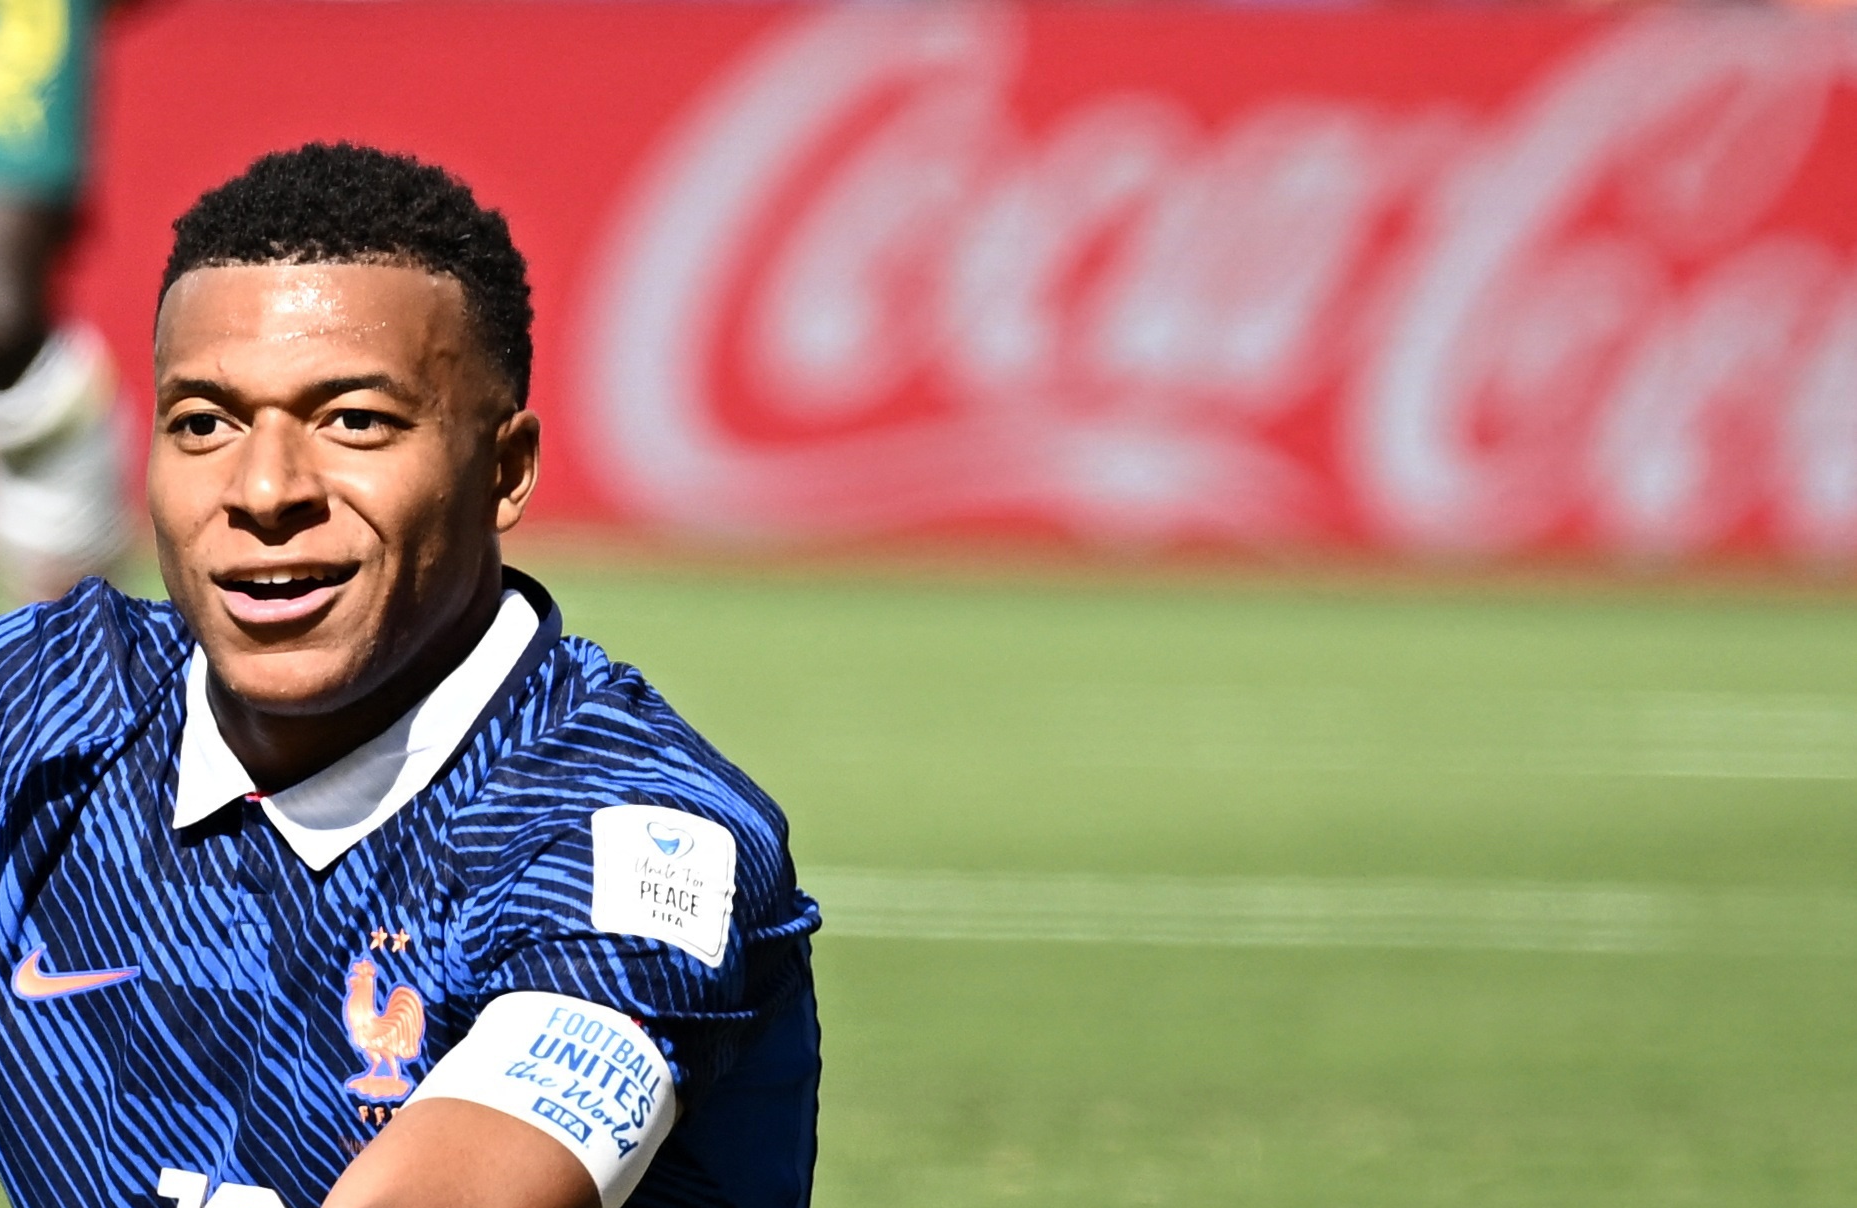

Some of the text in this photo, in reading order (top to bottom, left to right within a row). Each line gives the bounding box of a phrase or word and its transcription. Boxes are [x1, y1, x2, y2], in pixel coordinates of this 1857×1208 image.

[577, 0, 1857, 545] Coca-Co
[641, 880, 700, 918] PEACE
[652, 909, 683, 928] FIFA
[529, 1033, 651, 1129] UNITES
[546, 1007, 661, 1103] FOOTBALL
[505, 1059, 639, 1159] the World
[535, 1098, 589, 1142] FIFA
